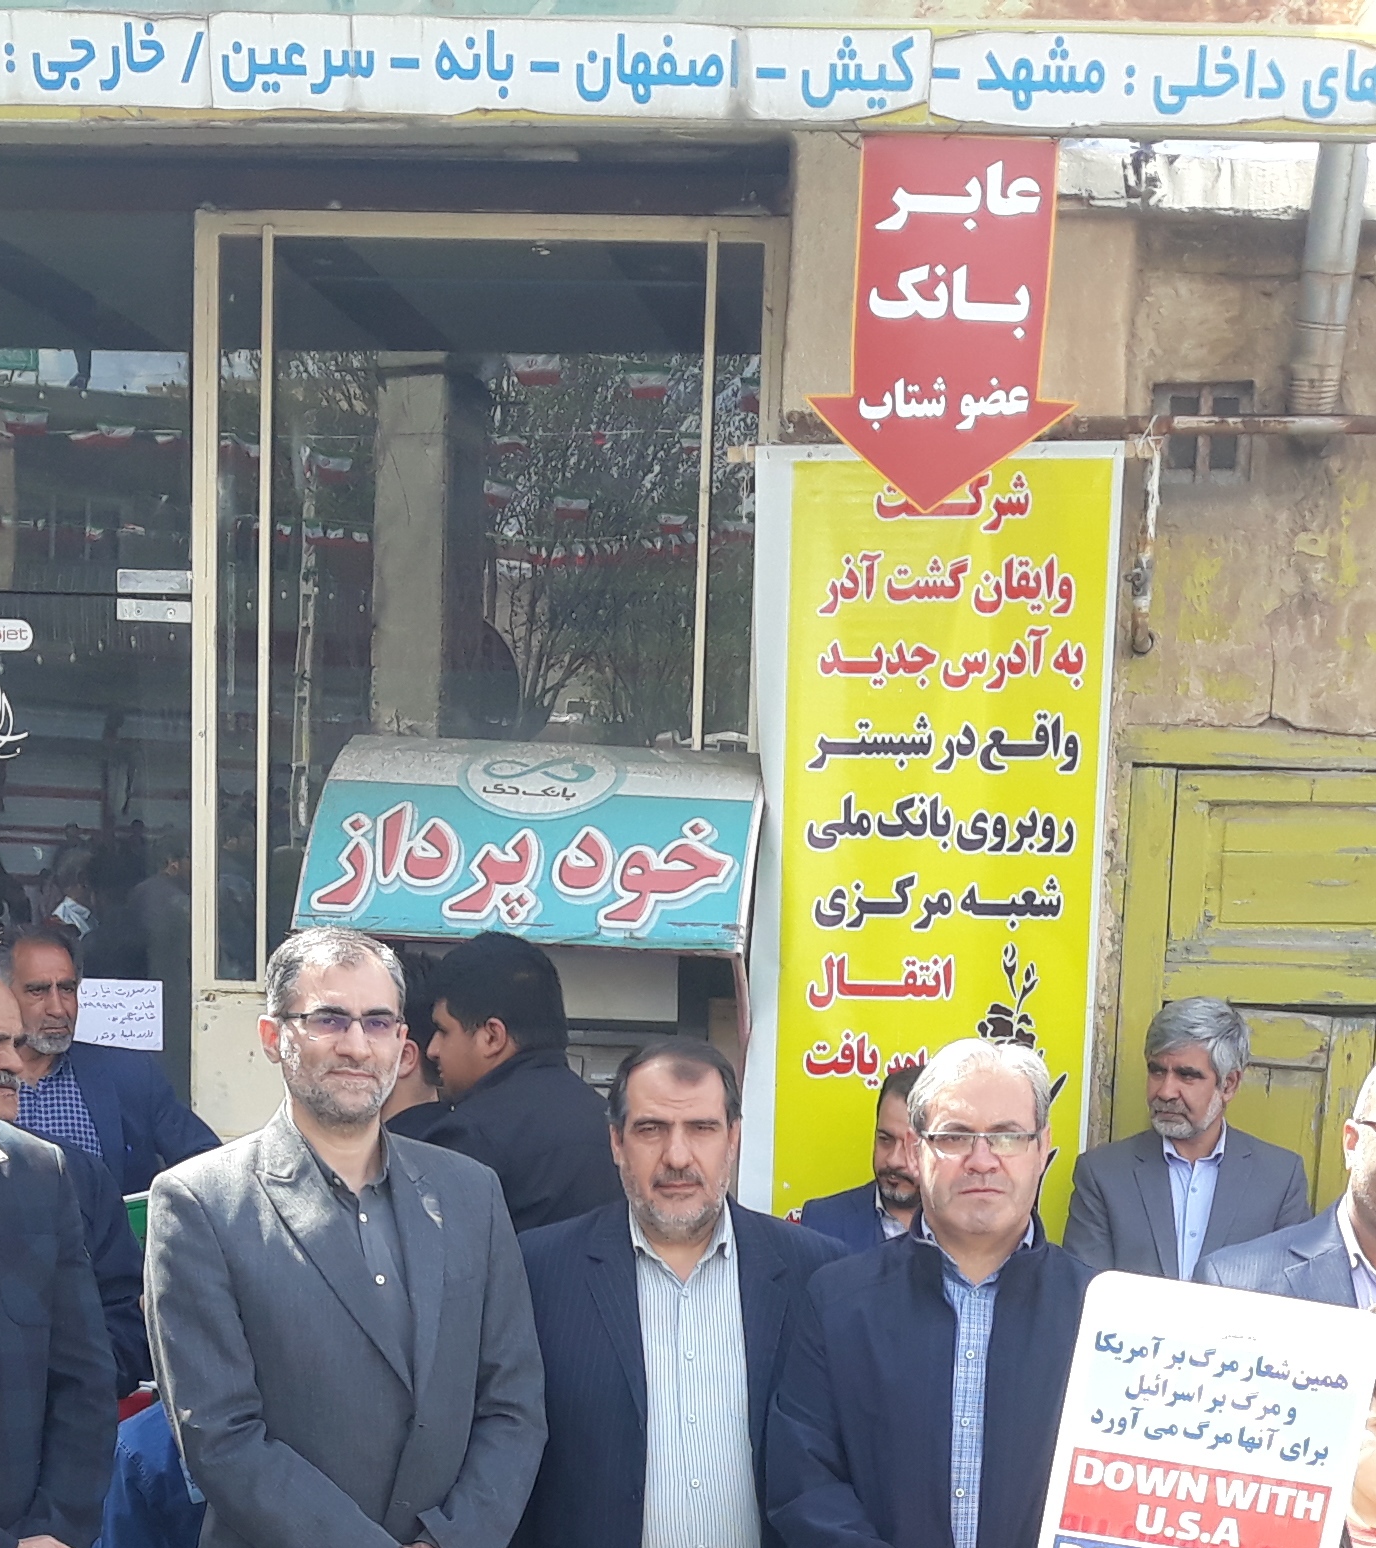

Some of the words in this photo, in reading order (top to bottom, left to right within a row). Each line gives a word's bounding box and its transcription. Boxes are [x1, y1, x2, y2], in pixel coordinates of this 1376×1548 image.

[32, 18, 165, 92] خارجی
[222, 40, 375, 93] سرعین
[434, 30, 514, 100] بانه
[575, 33, 738, 103] اصفهان
[801, 35, 913, 109] کیش
[977, 35, 1105, 111] مشهد
[1153, 44, 1286, 115] داخلی
[875, 160, 1042, 231] عابر
[868, 264, 1030, 339] بانک
[858, 376, 946, 431] شتاب
[956, 377, 1029, 431] عضو
[817, 552, 882, 614] آذر
[886, 557, 969, 602] گشت
[974, 556, 1074, 614] وایقان
[818, 642, 937, 688] جدید
[942, 627, 1049, 689] آدرس
[1052, 641, 1085, 689] به
[805, 715, 932, 771] شبستر
[935, 722, 977, 772] در
[979, 711, 1080, 772] واقع
[522, 786, 577, 800] بانک
[807, 793, 873, 851] ملی
[877, 793, 953, 851] بانک
[957, 806, 1076, 854] روبروی
[316, 805, 533, 920] پرداز
[556, 820, 730, 922] خود
[815, 875, 953, 929] مرکزی
[960, 876, 1063, 930] شعبه
[807, 954, 953, 1009] انتقال
[805, 1033, 878, 1086] یافت
[1094, 1330, 1165, 1364] آمریکا
[1164, 1349, 1186, 1371] بر
[1189, 1348, 1239, 1378] مرگ
[1240, 1356, 1291, 1382] شعار
[1124, 1374, 1204, 1406] اسرائیل
[1204, 1393, 1227, 1413] بر
[1231, 1391, 1281, 1420] مرگ
[1293, 1370, 1349, 1391] همین
[1090, 1407, 1145, 1435] آورد
[1144, 1422, 1179, 1440] می
[1183, 1421, 1233, 1449] مرگ
[1236, 1426, 1280, 1453] آنها
[1282, 1405, 1297, 1424] و
[1279, 1436, 1329, 1466] برای
[1074, 1455, 1211, 1504] DOWN
[1216, 1476, 1325, 1522] WITH
[1135, 1503, 1241, 1548] U.S.A
